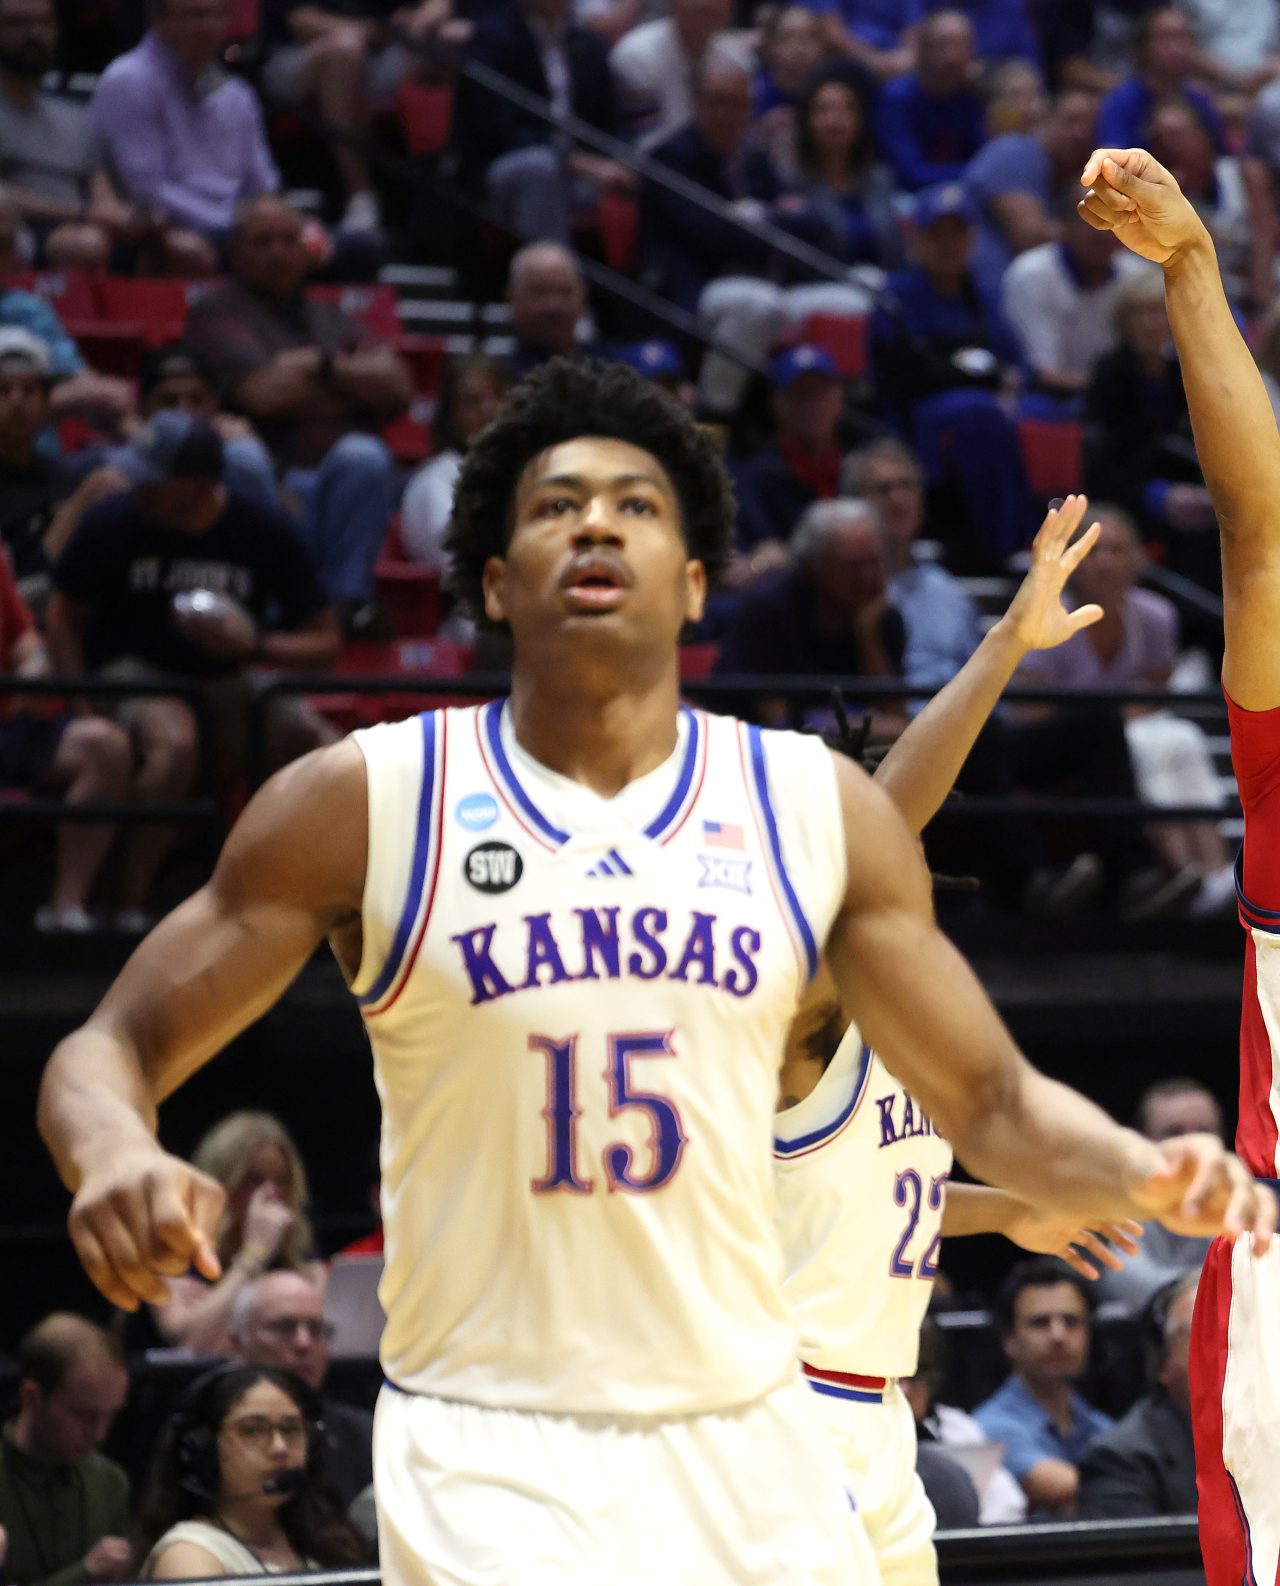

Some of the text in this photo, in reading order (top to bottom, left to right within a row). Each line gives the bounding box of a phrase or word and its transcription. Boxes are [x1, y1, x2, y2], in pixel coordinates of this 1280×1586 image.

[468, 849, 516, 885] SW
[452, 904, 760, 1006] KANSAS
[527, 1027, 690, 1196] 15
